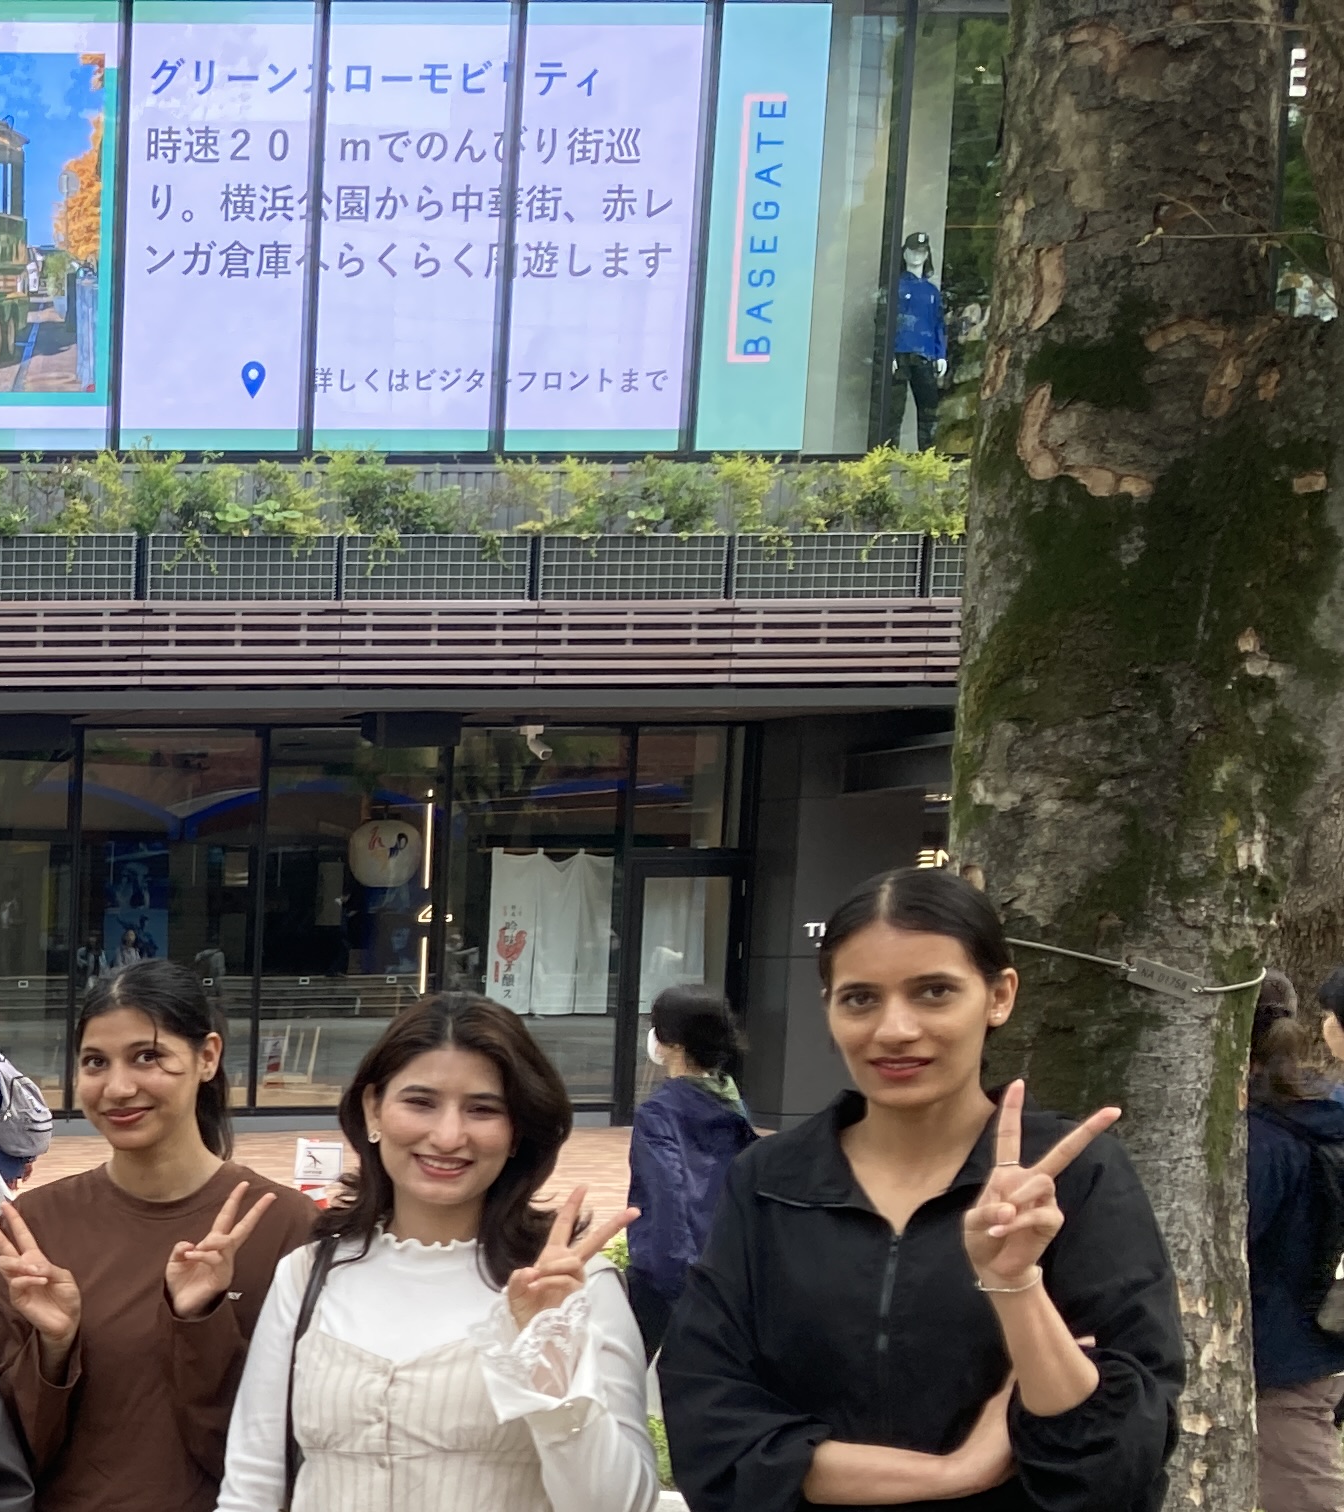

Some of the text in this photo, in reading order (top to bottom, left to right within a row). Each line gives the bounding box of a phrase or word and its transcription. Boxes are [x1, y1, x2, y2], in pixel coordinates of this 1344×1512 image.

[150, 58, 599, 96] グリーンローモビティ
[743, 100, 787, 356] BASEGATE
[312, 368, 669, 393] 詳しくはビジタフロントまで
